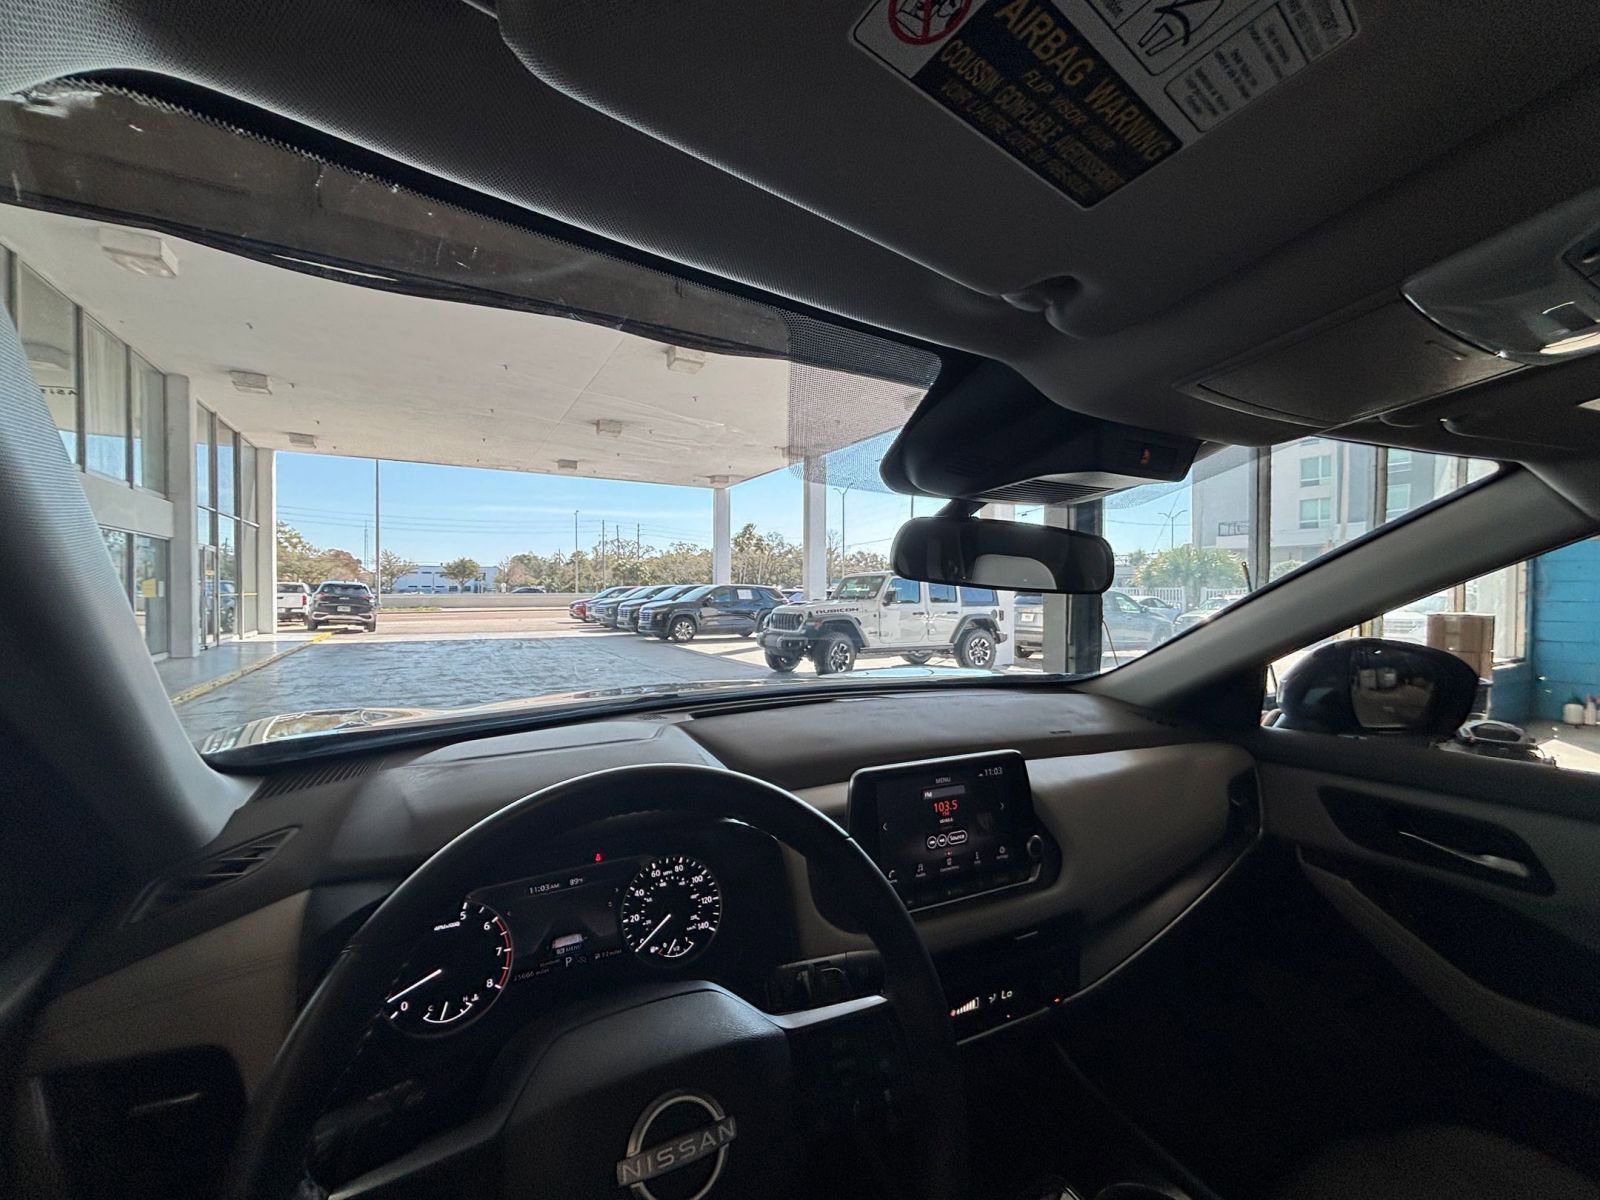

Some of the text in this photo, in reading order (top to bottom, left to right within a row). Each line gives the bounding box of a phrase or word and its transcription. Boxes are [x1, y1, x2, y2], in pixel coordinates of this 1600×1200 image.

[940, 39, 1005, 96] COUSSIN
[992, 0, 1096, 88] AIRBAG
[1083, 76, 1174, 162] WARNING
[1022, 68, 1056, 94] FLIP
[1049, 93, 1089, 127] VISOR
[815, 606, 860, 615] RUBICON
[984, 766, 1004, 777] 11:03
[935, 776, 952, 784] MENU
[933, 800, 958, 813] 103.5
[651, 869, 661, 878] 60
[674, 864, 684, 873] 80
[691, 875, 704, 884] 100
[634, 888, 645, 898] 40
[701, 895, 713, 905] 120
[460, 911, 467, 921] 5
[629, 913, 640, 923] 20
[483, 921, 491, 931] 6
[697, 921, 710, 931] 140
[495, 946, 502, 957] 7
[565, 957, 572, 968] P
[486, 977, 495, 988] 8
[1001, 989, 1013, 1000] Lo
[400, 1000, 409, 1012] 0
[621, 1119, 736, 1184] NISSAN
